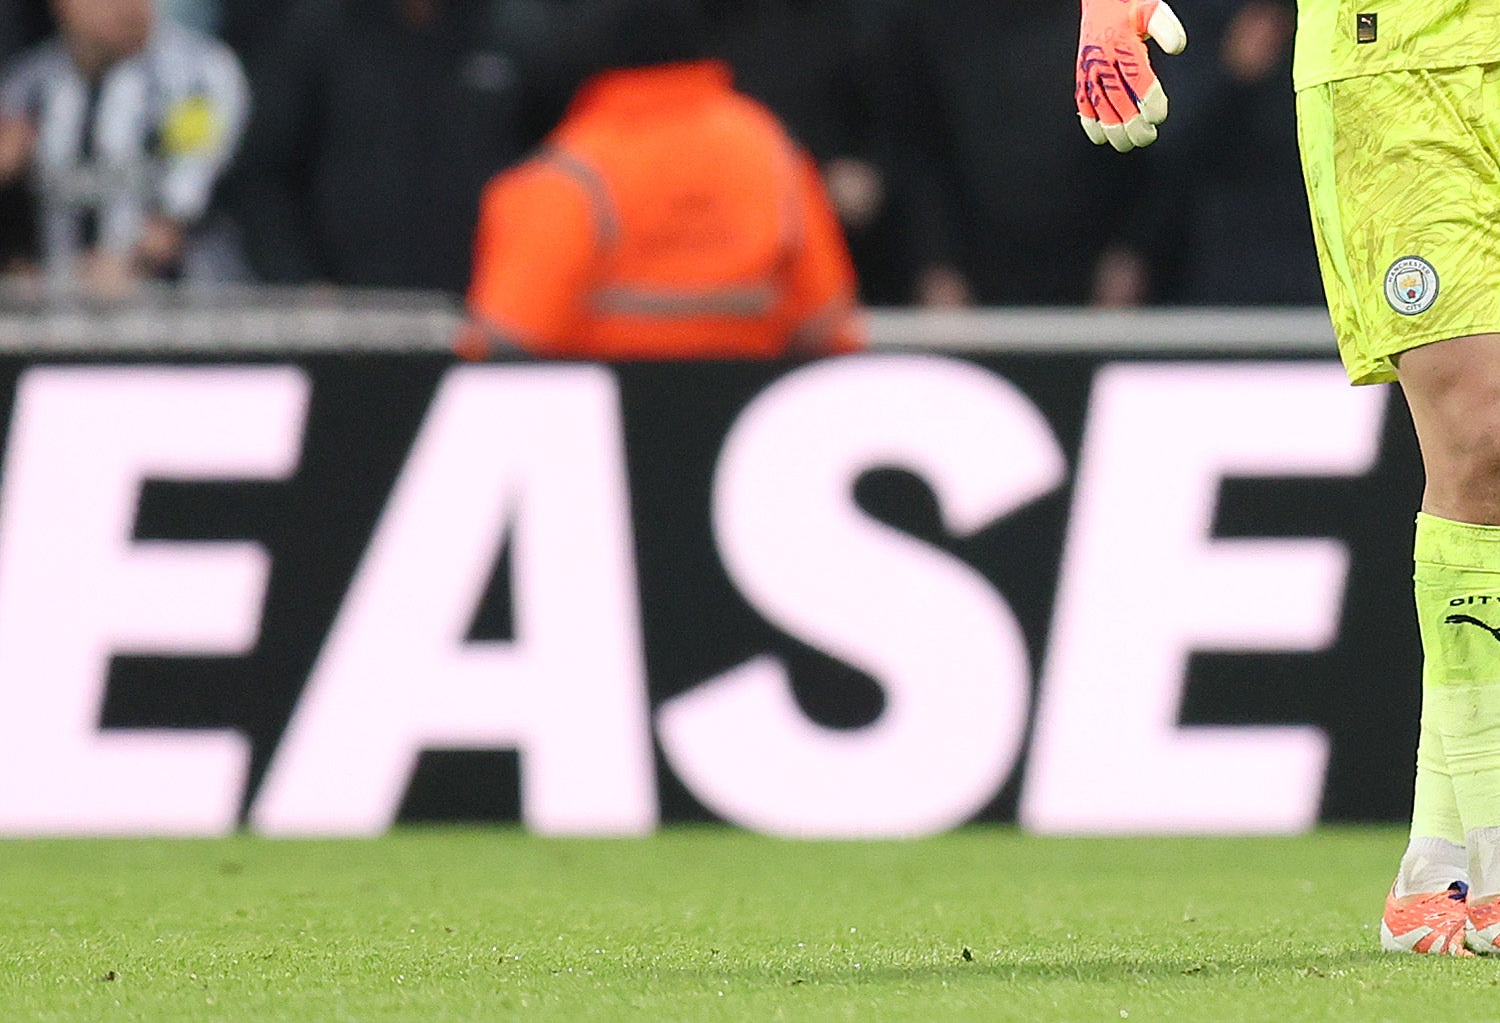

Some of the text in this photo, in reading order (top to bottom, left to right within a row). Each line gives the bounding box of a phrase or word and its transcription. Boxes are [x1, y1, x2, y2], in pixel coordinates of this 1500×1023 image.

[1388, 261, 1430, 283] MANCHESTER
[1405, 303, 1422, 311] CITY
[0, 352, 1391, 839] EASE
